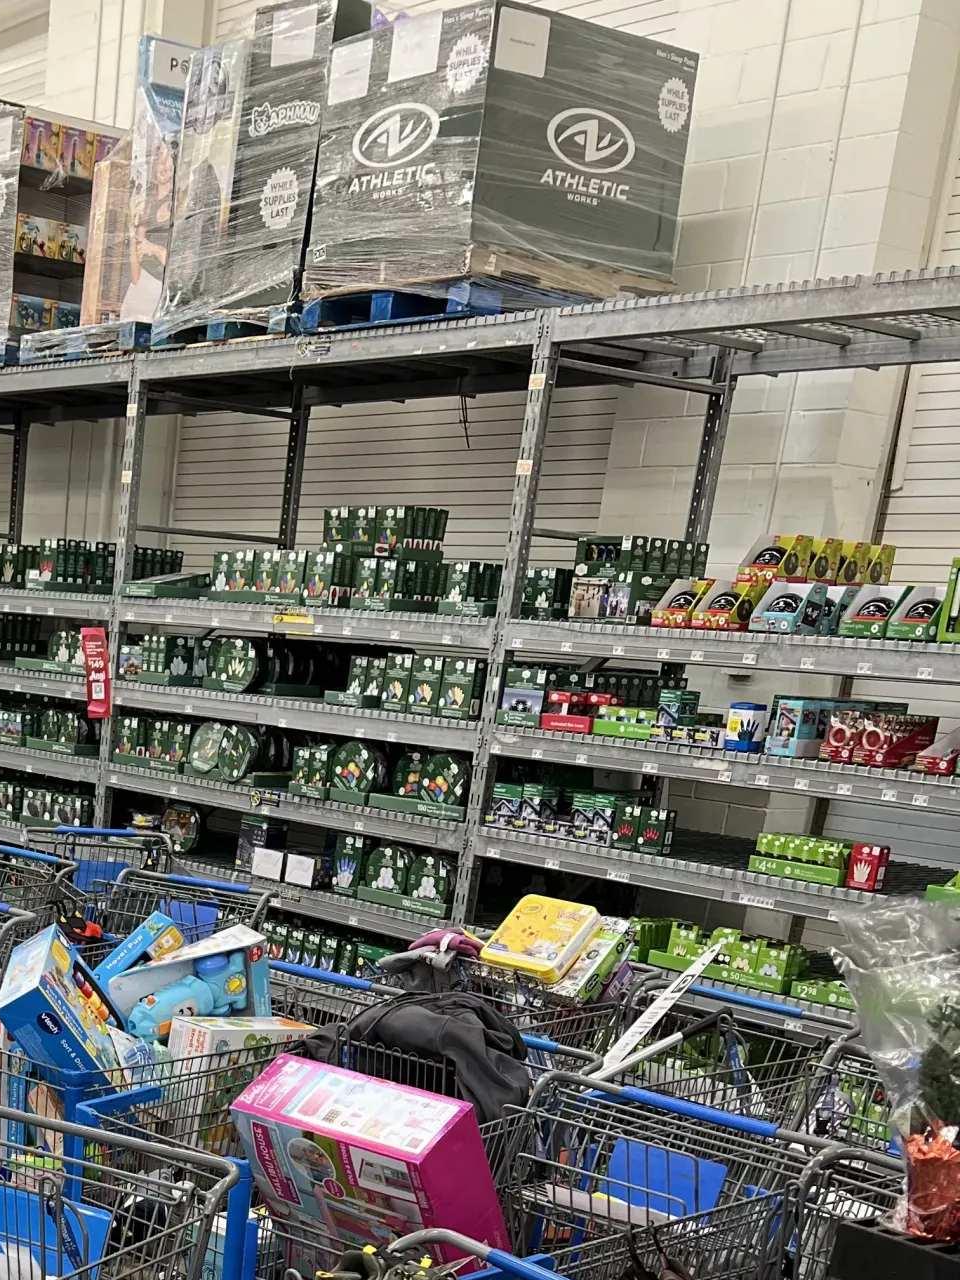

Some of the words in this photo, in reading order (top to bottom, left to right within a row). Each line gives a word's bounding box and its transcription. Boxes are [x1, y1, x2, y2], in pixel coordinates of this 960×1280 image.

[455, 44, 478, 57] WHILE
[449, 55, 482, 71] SUPPLIES
[666, 86, 685, 101] WHILE
[661, 98, 687, 113] SUPPLIES
[269, 103, 321, 127] APHMAU
[664, 110, 680, 123] LAST
[348, 162, 436, 194] ATHLETIC
[540, 168, 630, 201] ATHLETIC
[270, 182, 294, 192] WHILE
[372, 187, 403, 199] WORKS
[263, 192, 296, 205] SUPPLIES
[567, 192, 599, 206] WORKS
[270, 207, 289, 219] LAST
[88, 660, 104, 668] $149
[89, 671, 106, 681] Angi
[417, 803, 427, 812] 100
[402, 899, 413, 908] 100
[105, 948, 128, 970] Hover
[128, 934, 143, 950] Pup
[730, 972, 740, 981] 50
[41, 1012, 59, 1034] vtech
[60, 1038, 72, 1052] Sort
[240, 1083, 265, 1104] Barbie
[253, 1126, 270, 1160] HOUSE
[266, 1163, 284, 1197] MALIBU
